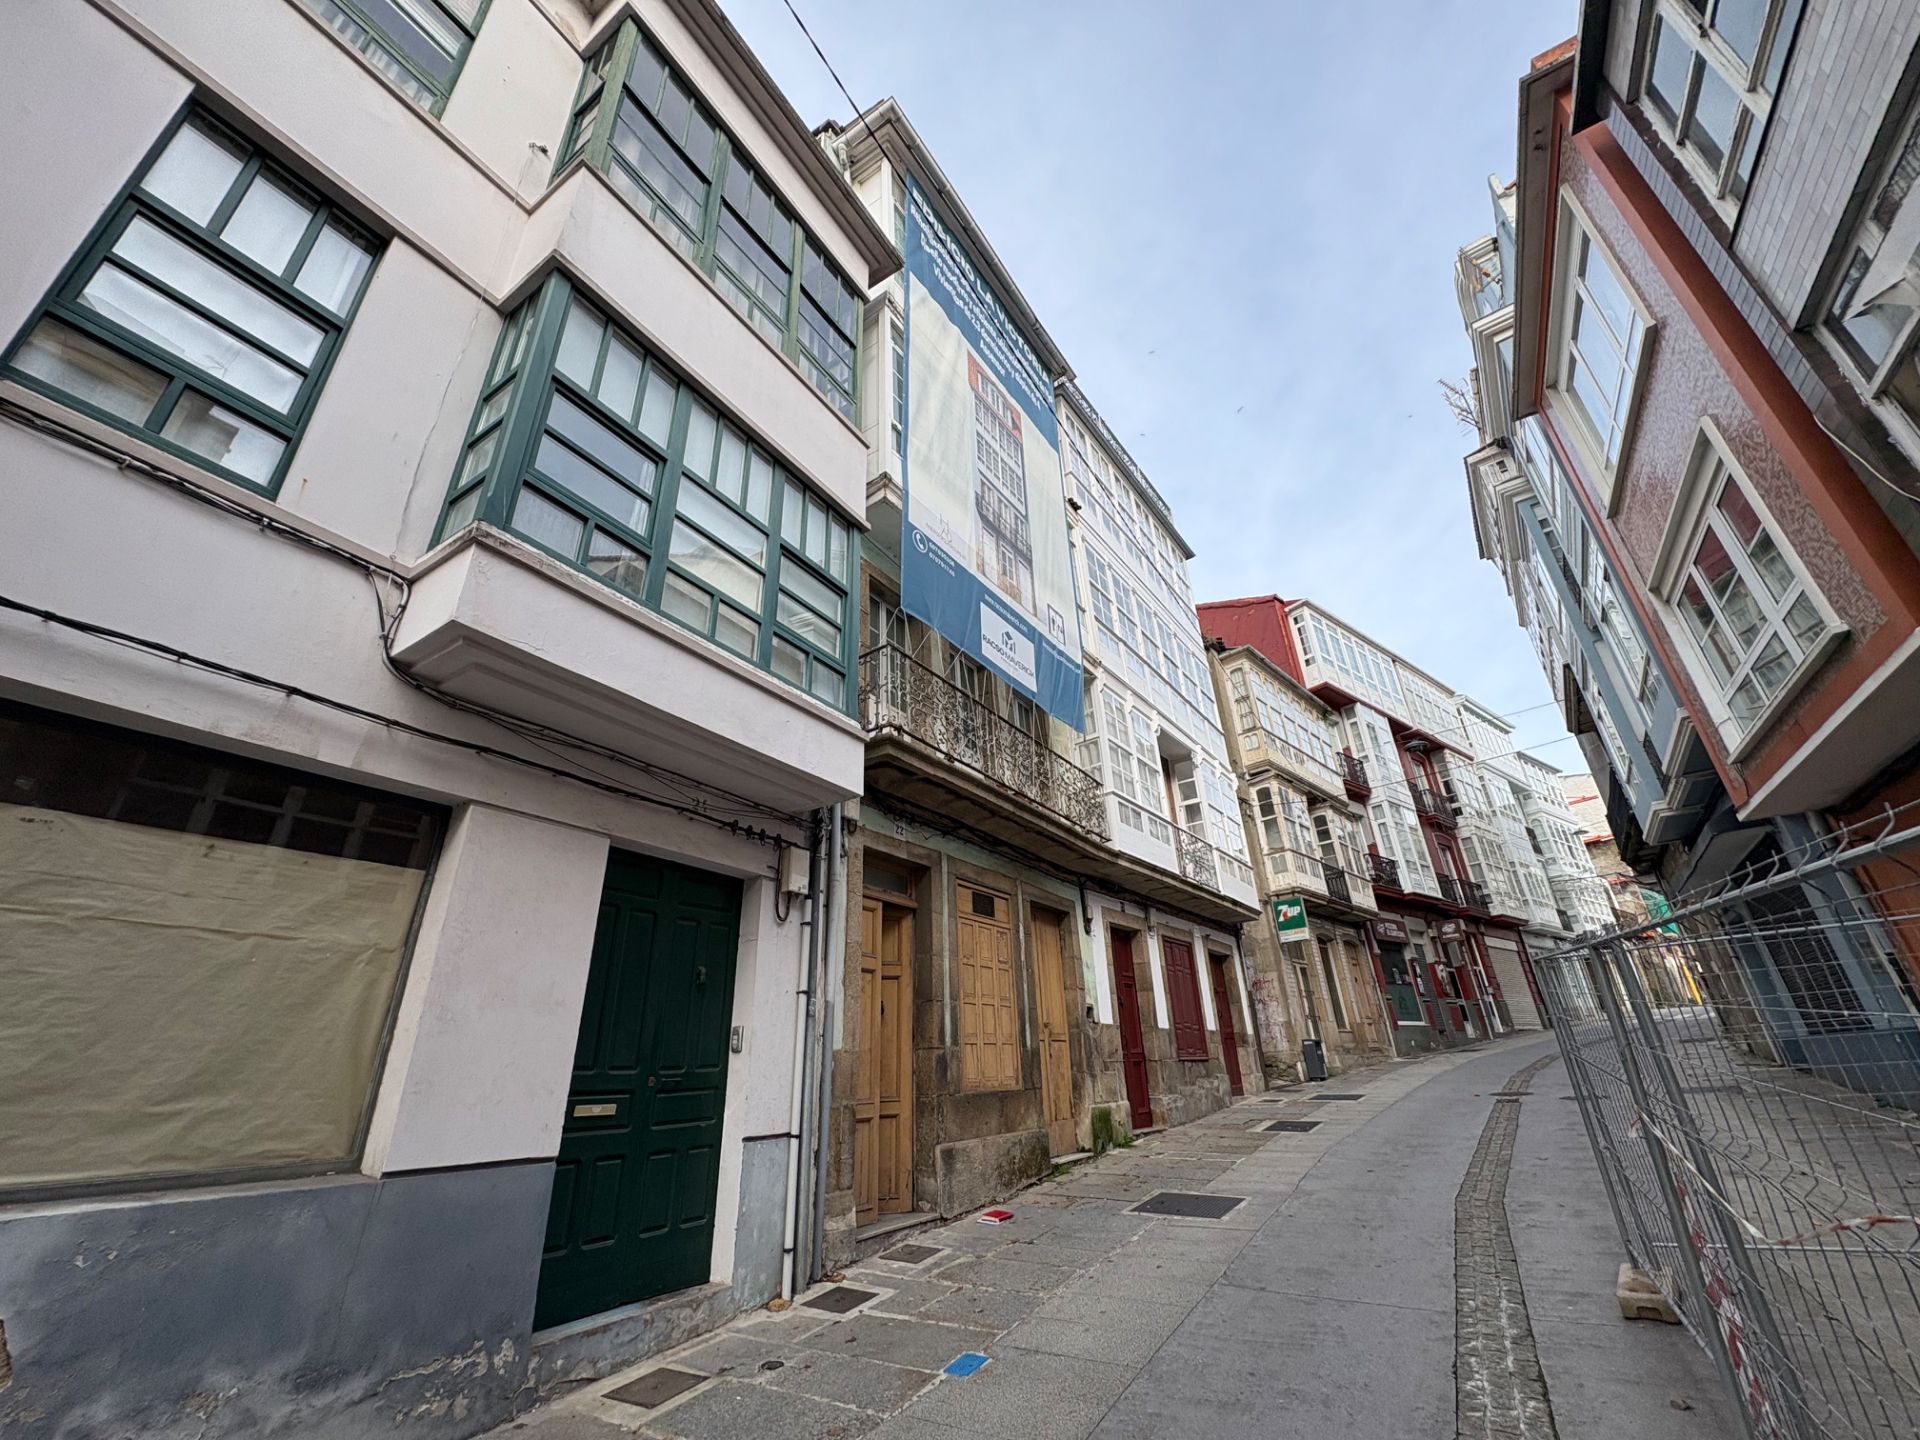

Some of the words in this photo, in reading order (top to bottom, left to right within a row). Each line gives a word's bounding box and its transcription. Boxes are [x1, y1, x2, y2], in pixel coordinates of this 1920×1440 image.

[912, 185, 976, 281] EDIFICIO
[976, 277, 995, 314] LA
[995, 303, 1050, 384] VICTORIA
